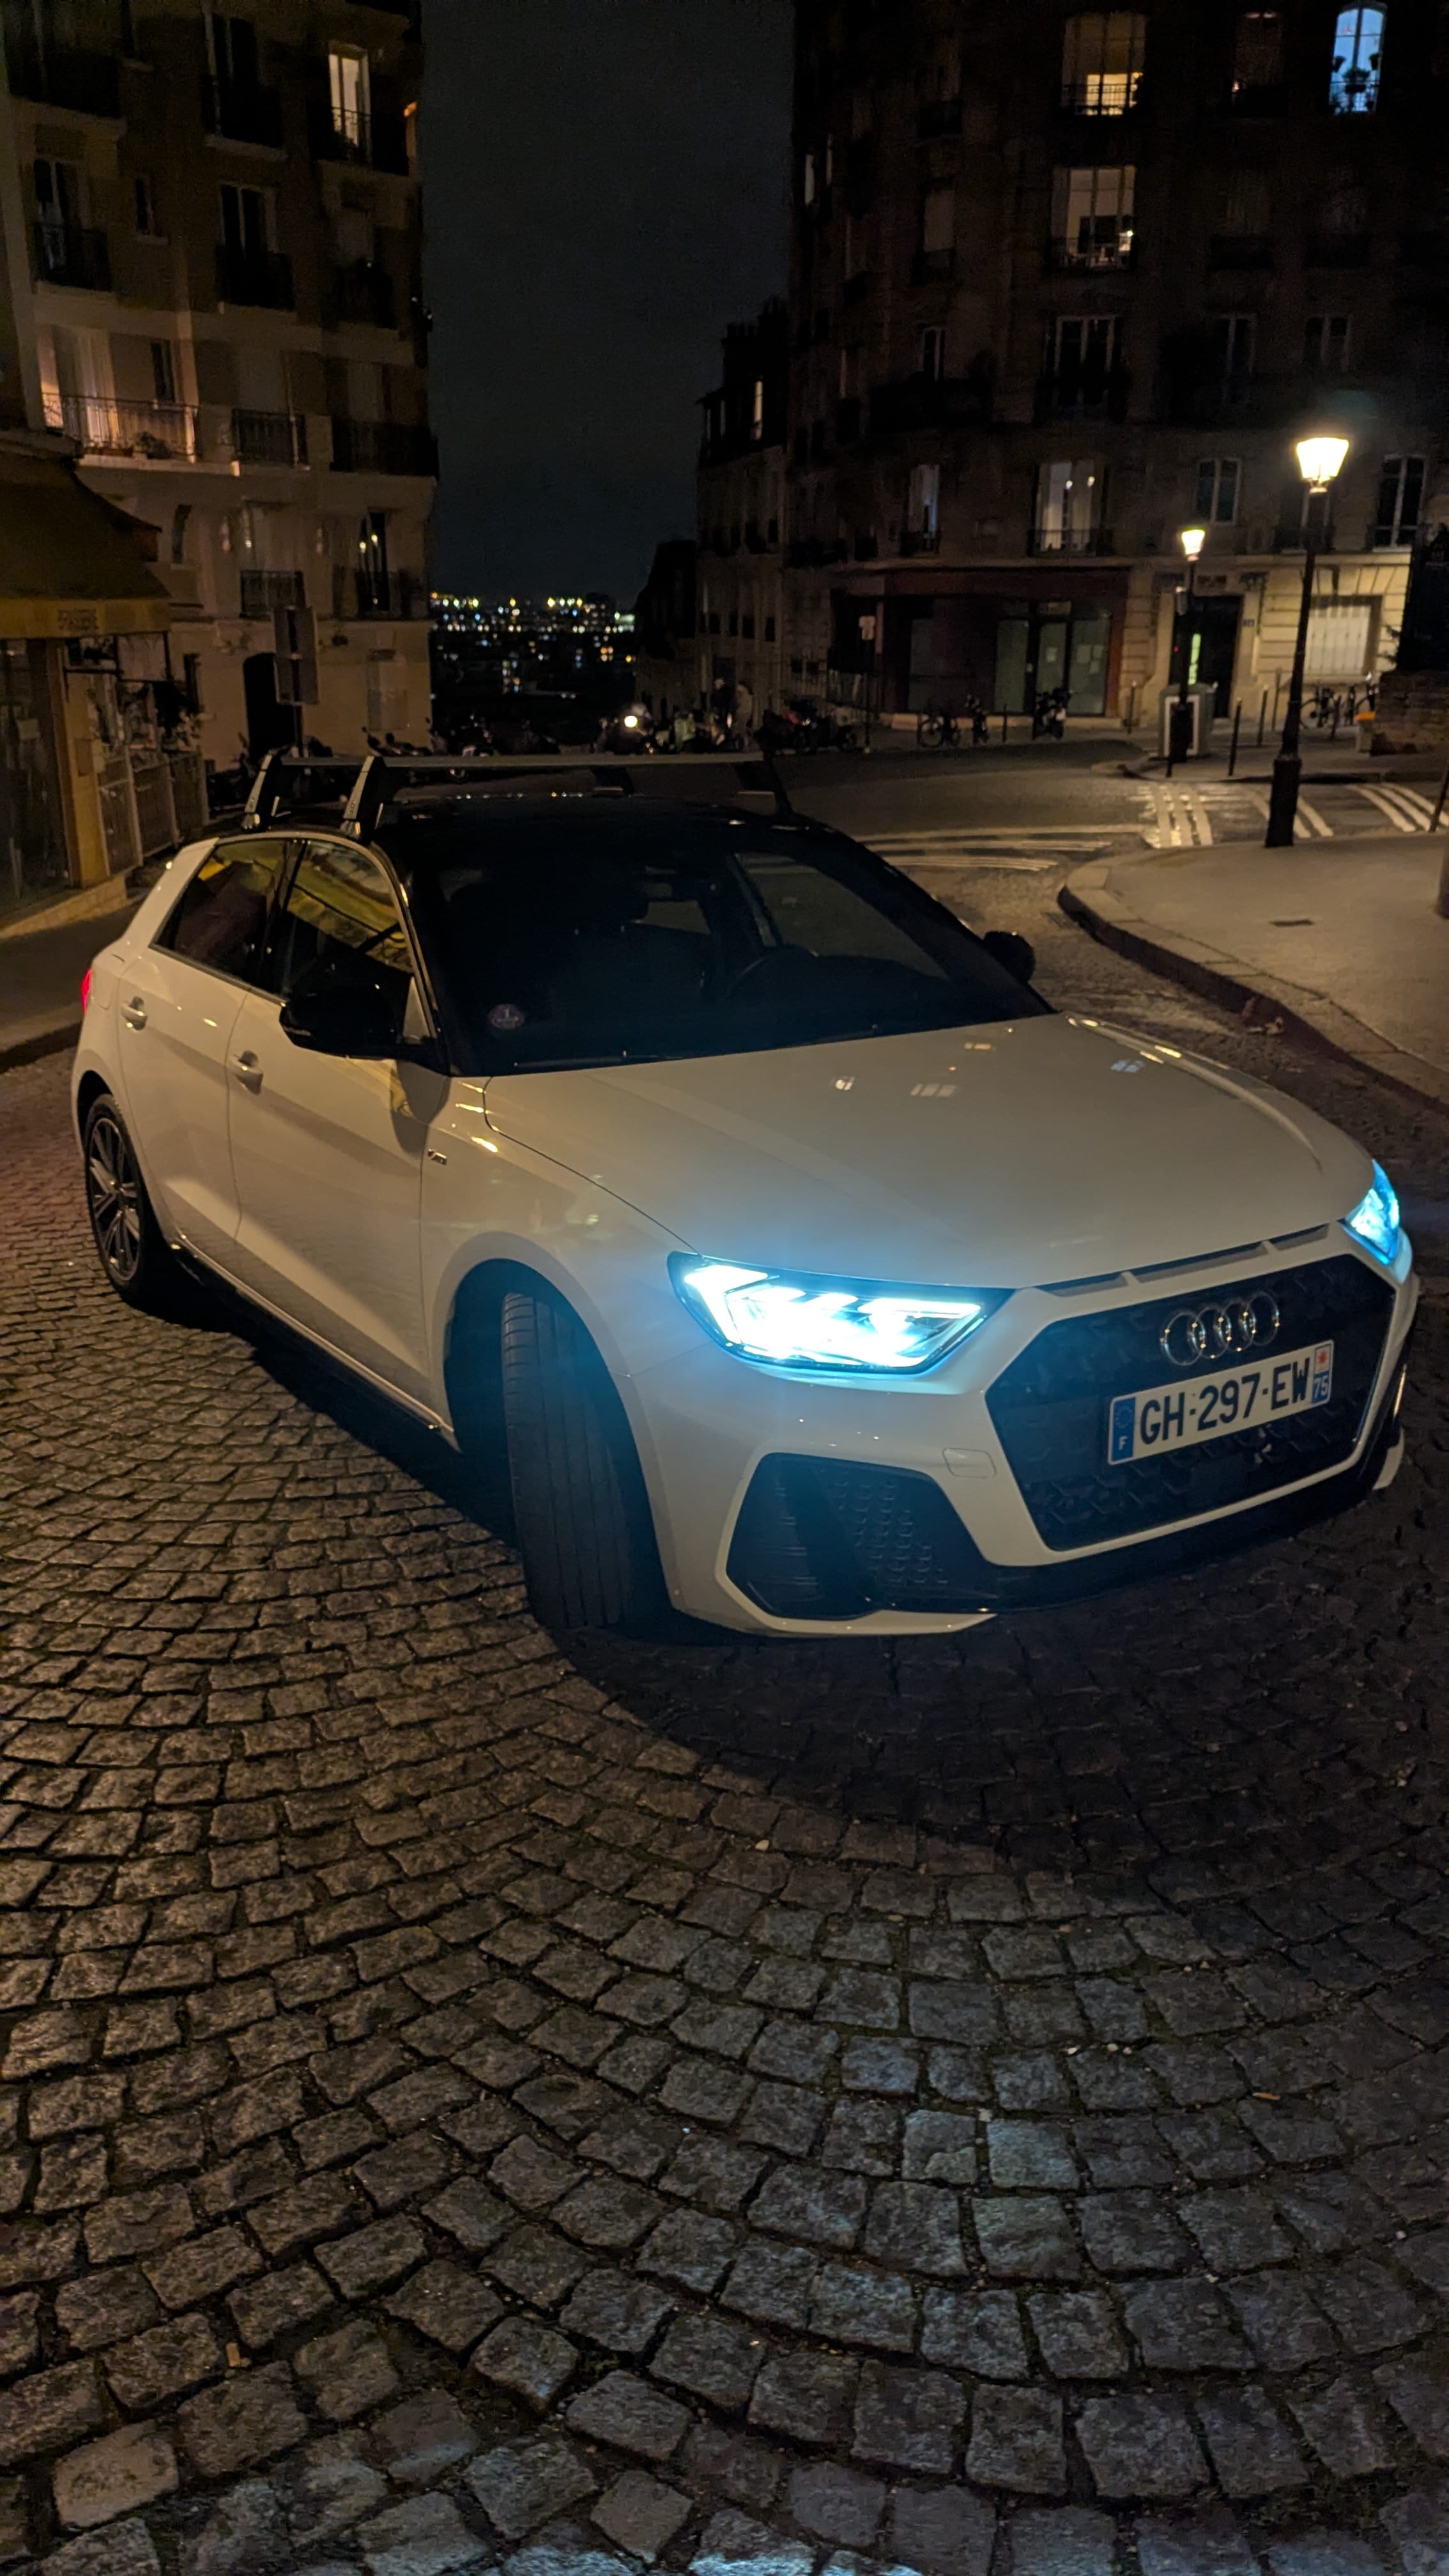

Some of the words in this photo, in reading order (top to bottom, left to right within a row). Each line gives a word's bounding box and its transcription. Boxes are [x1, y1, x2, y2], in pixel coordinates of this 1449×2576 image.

[1119, 1436, 1127, 1450] F
[1140, 1358, 1310, 1445] GH-297-EW
[1313, 1377, 1330, 1398] 75
